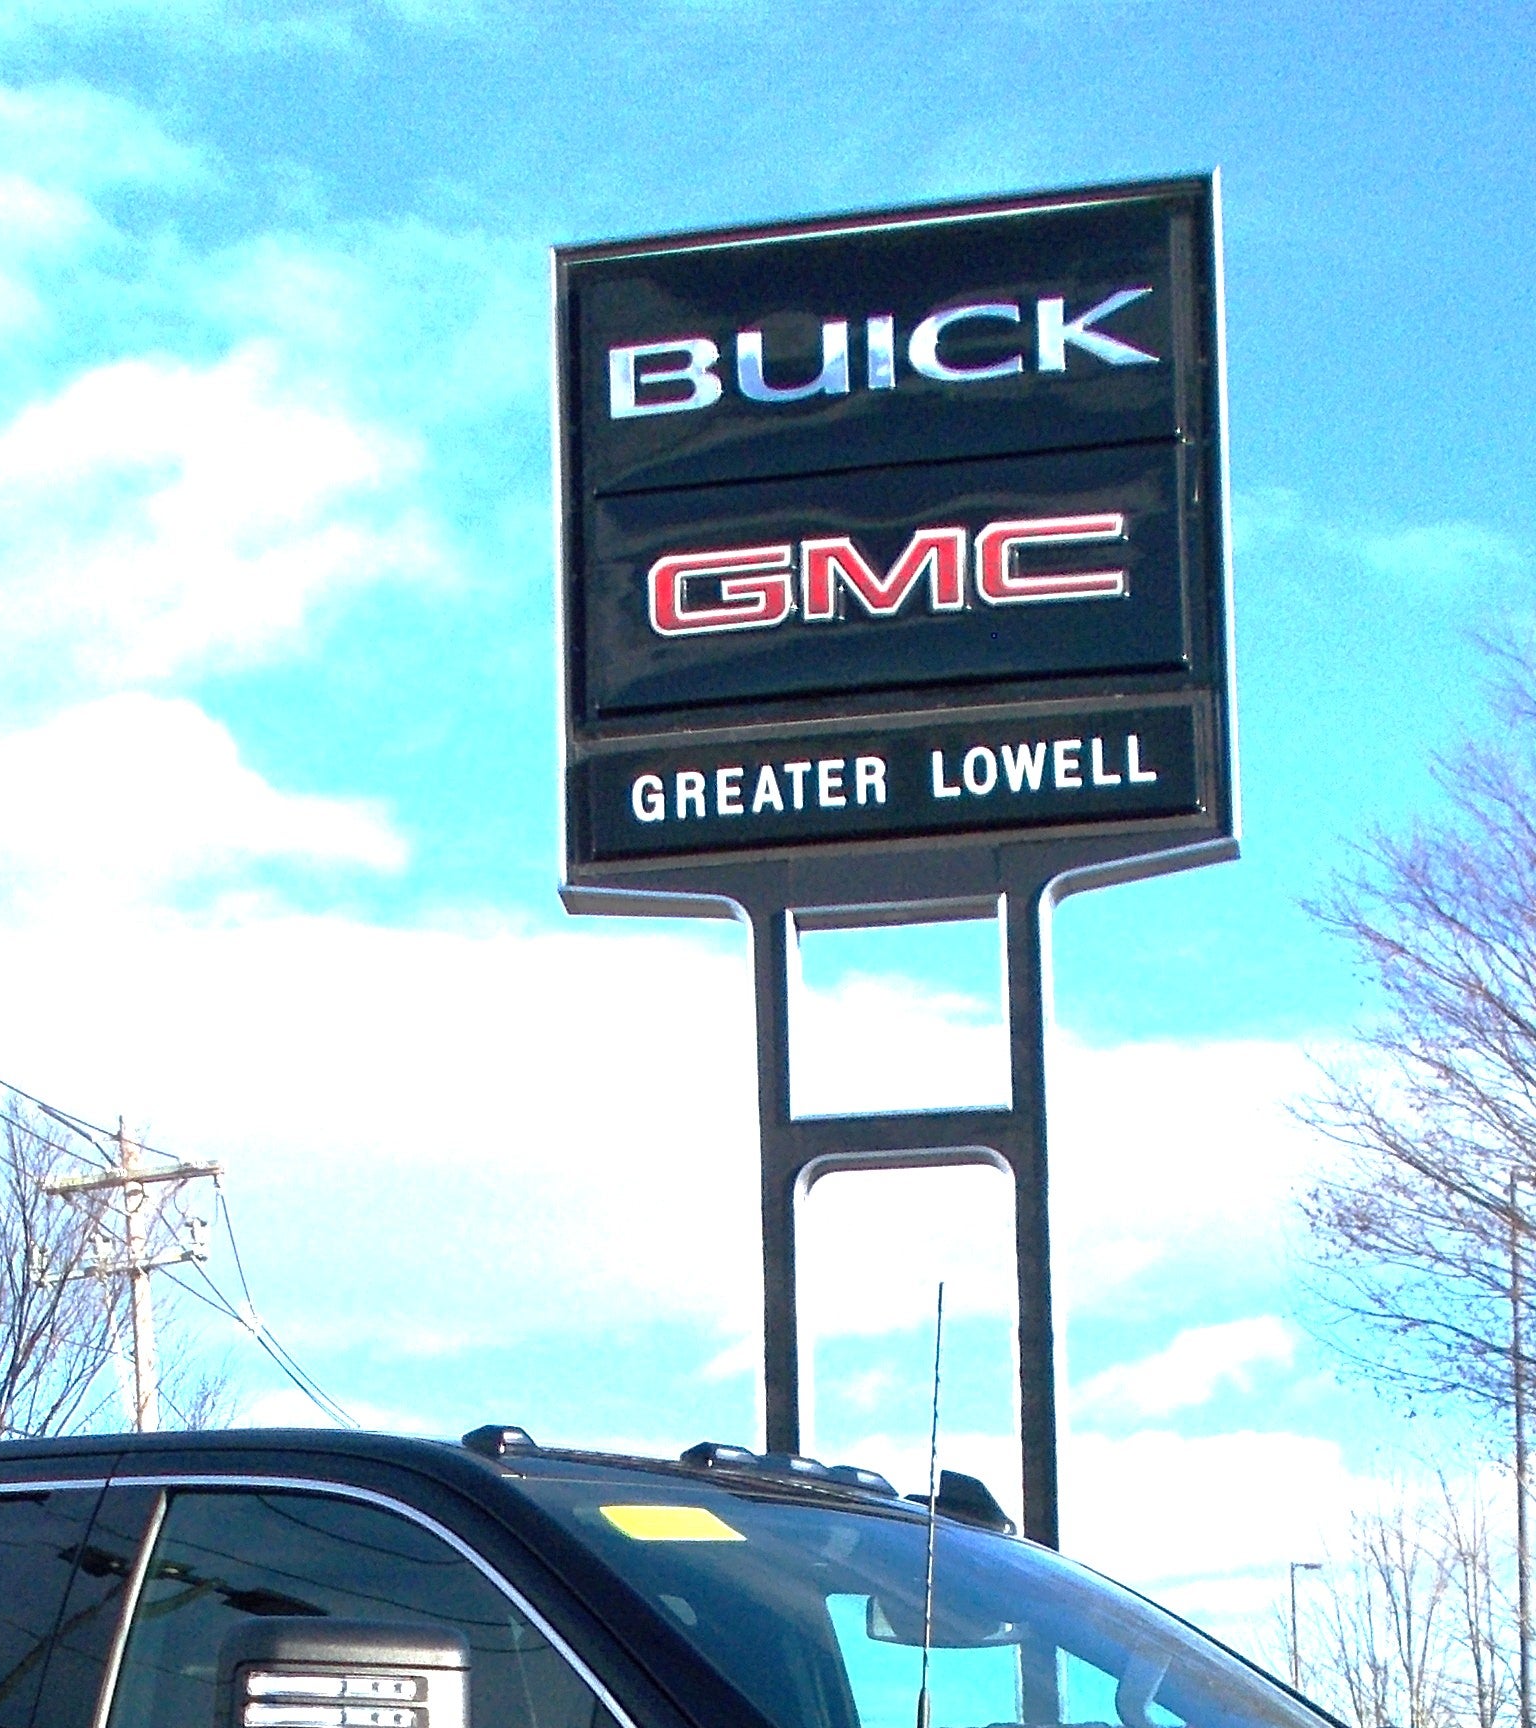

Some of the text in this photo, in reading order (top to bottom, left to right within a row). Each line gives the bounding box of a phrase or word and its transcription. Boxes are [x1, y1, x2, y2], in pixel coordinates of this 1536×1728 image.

[608, 285, 1161, 420] BUICK
[647, 513, 1126, 637] GMC
[631, 733, 1158, 823] GREATER LOWELL
